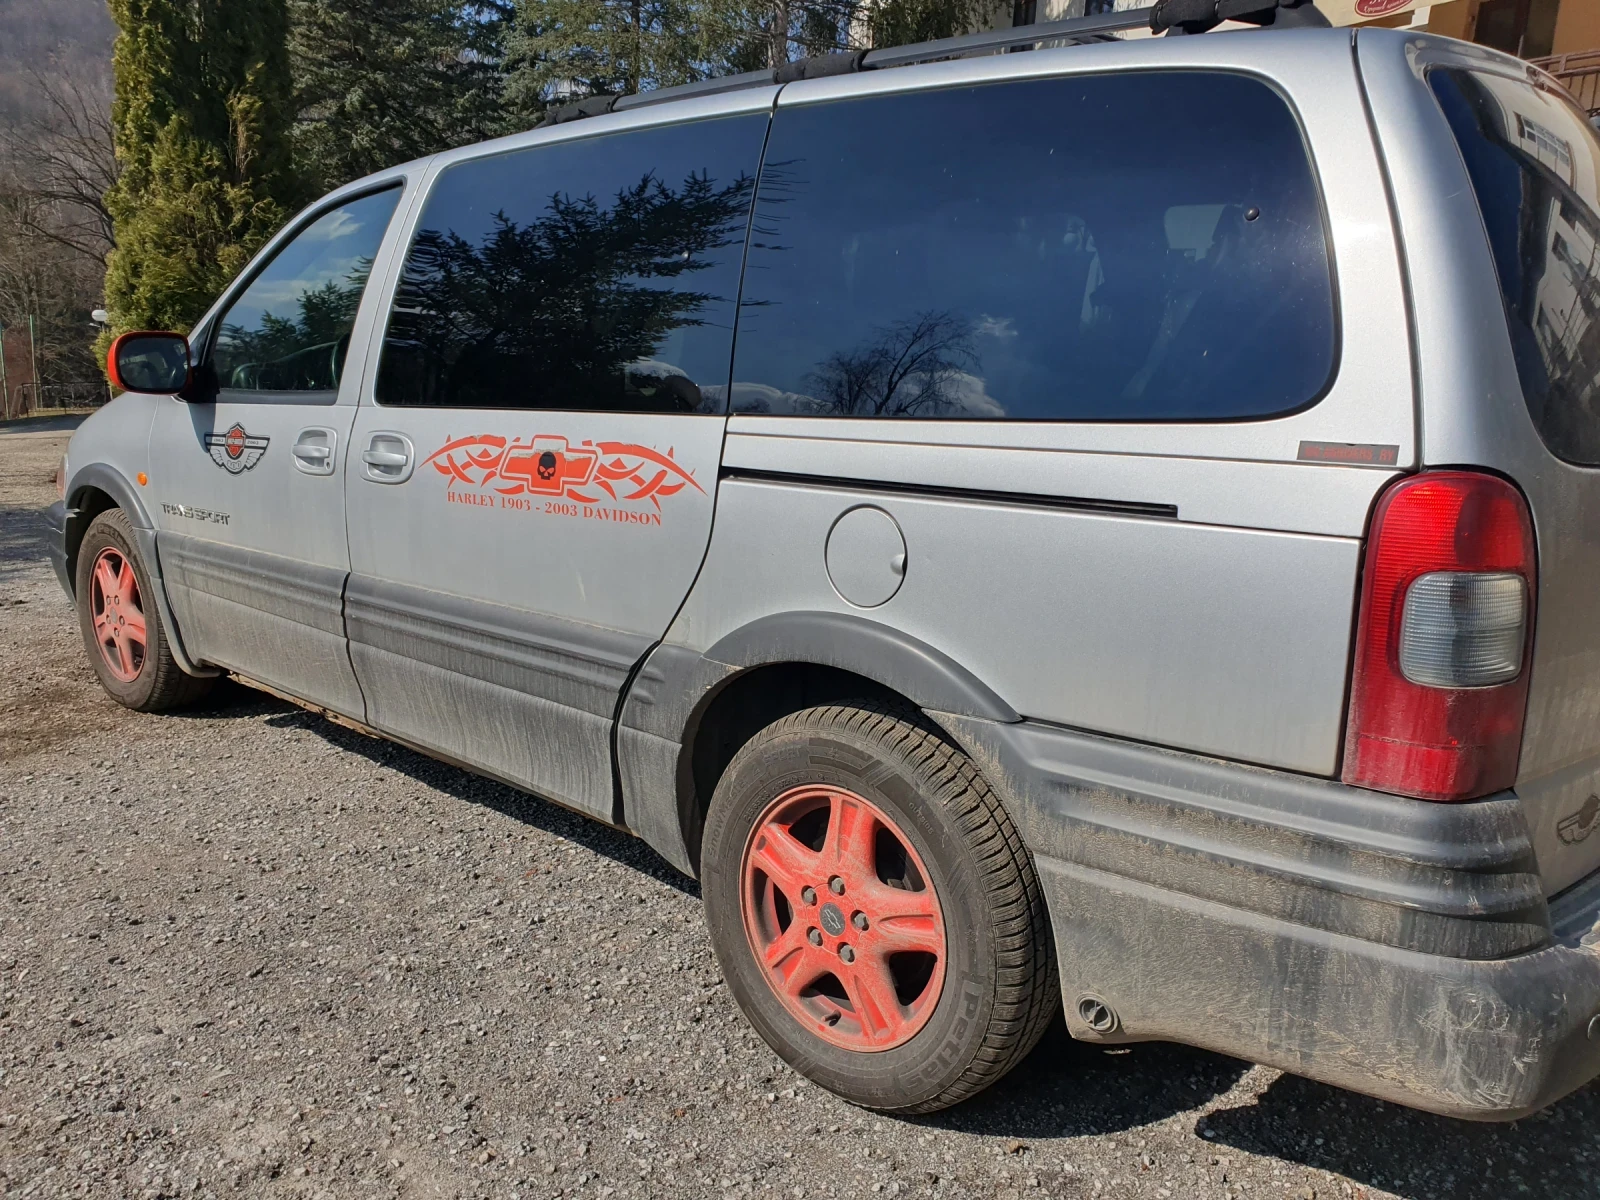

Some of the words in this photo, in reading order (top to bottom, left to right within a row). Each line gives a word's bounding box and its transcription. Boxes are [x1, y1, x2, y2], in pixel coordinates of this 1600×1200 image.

[447, 491, 496, 507] HARLEY
[500, 496, 531, 511] 1903
[544, 502, 578, 517] 2003
[583, 506, 662, 526] DAVIDSON
